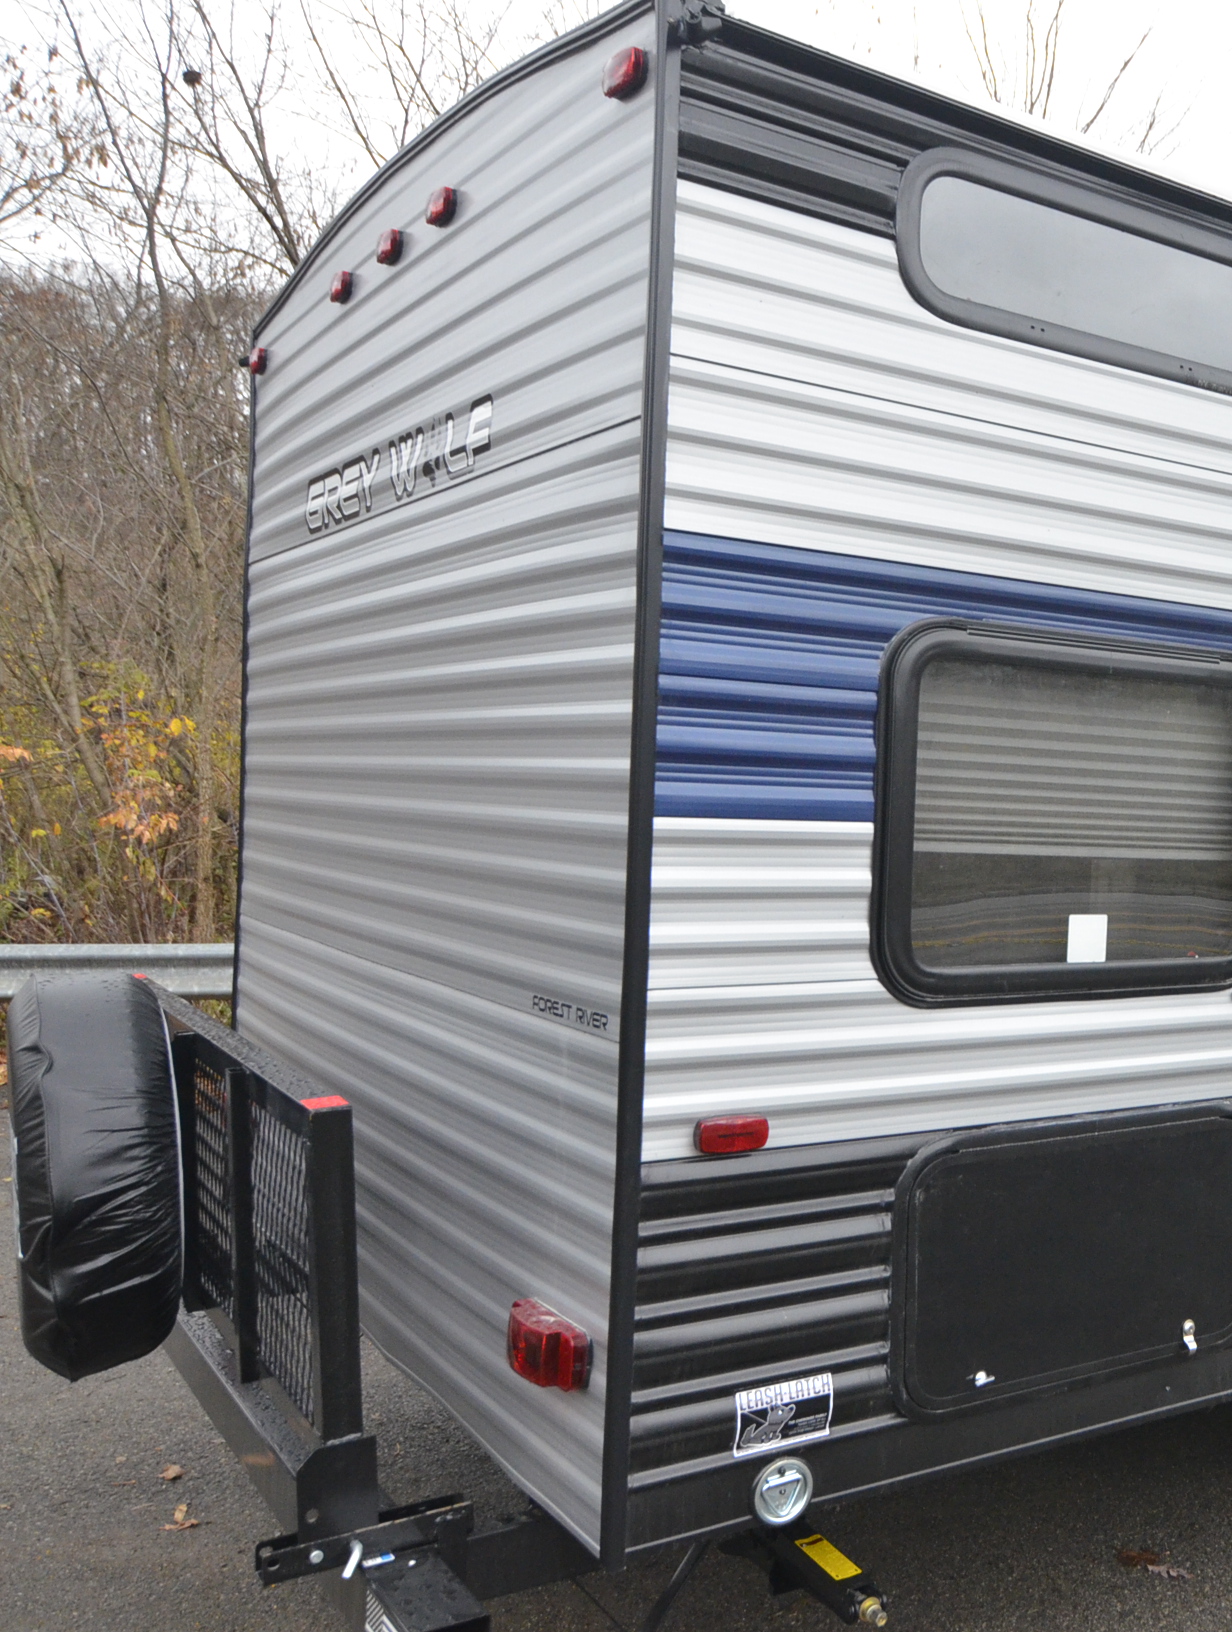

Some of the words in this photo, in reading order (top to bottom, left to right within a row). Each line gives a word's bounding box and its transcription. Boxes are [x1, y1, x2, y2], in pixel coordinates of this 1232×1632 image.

[305, 447, 379, 534] GREY
[532, 995, 572, 1020] FOREST
[575, 1005, 609, 1031] RIVER
